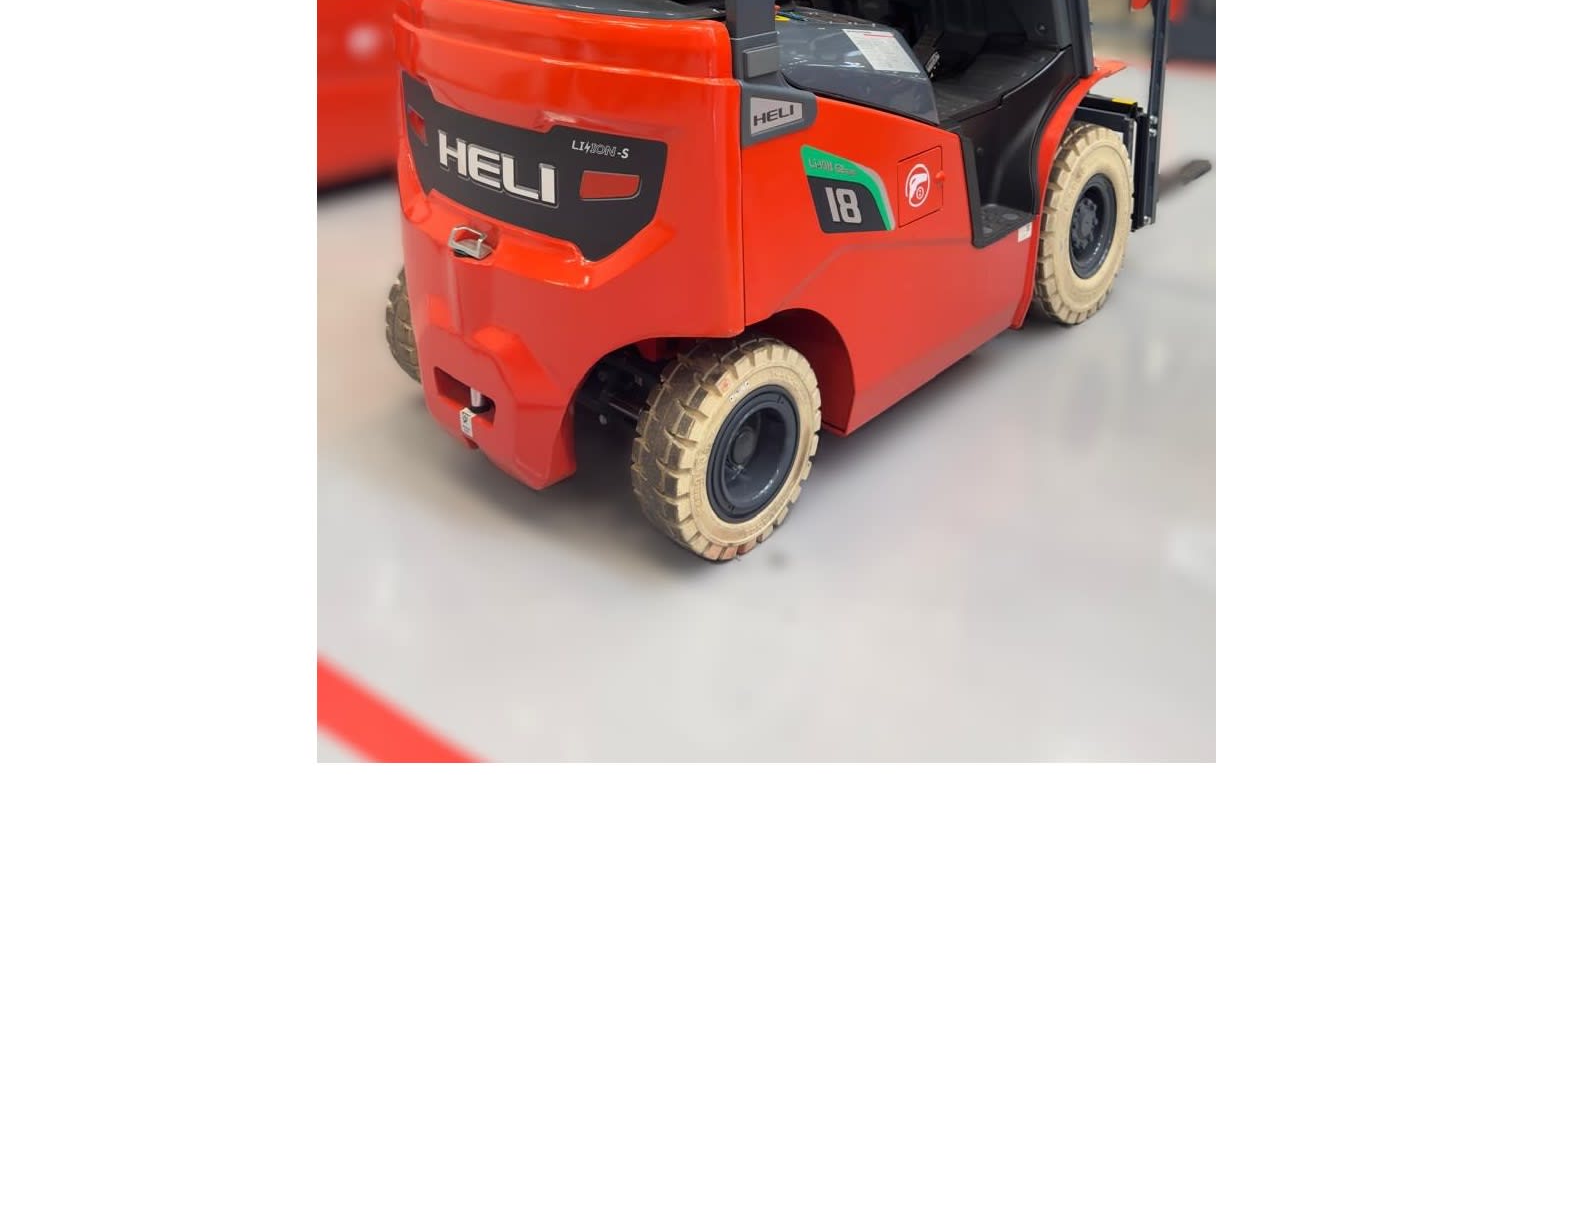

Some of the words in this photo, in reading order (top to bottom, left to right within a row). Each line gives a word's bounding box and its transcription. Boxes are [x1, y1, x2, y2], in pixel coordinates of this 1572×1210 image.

[753, 104, 794, 126] HELI
[438, 129, 559, 208] HELI
[825, 186, 862, 224] 18
